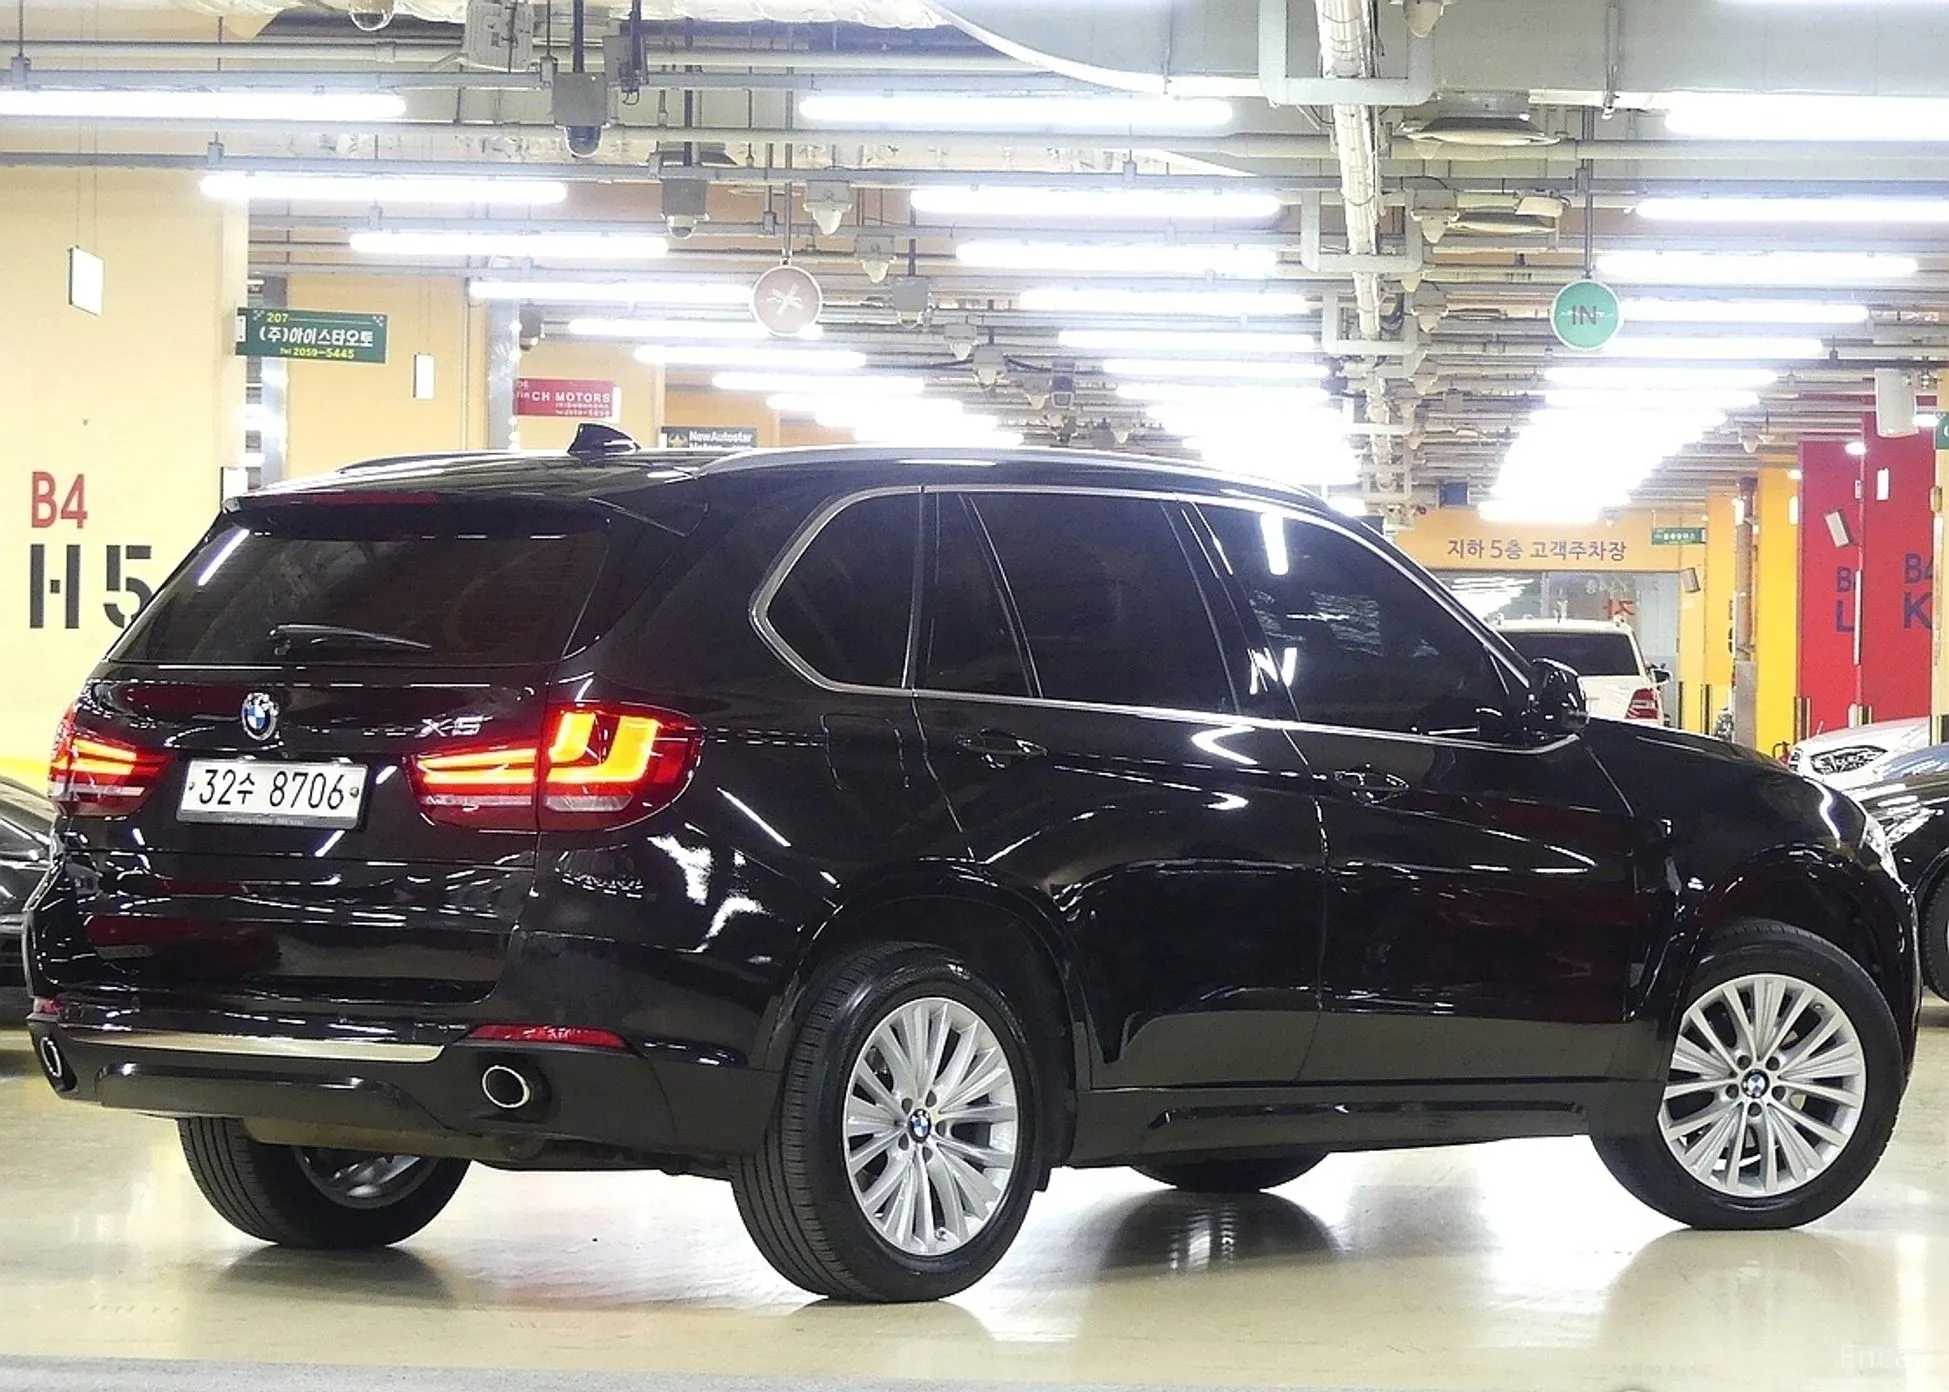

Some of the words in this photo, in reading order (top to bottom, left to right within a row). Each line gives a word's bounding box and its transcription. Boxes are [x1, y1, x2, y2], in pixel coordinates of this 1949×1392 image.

[266, 312, 289, 323] 207
[1571, 305, 1597, 325] IN
[293, 347, 355, 359] 2059-5445
[555, 392, 610, 403] MOTORS
[31, 471, 88, 529] B4
[1448, 539, 1484, 559] 지하
[1490, 539, 1523, 560] 5층
[1530, 540, 1627, 561] 고객주차장
[1837, 566, 1856, 592] B
[414, 715, 483, 738] X5
[199, 769, 255, 805] 32수
[269, 771, 344, 810] 8706
